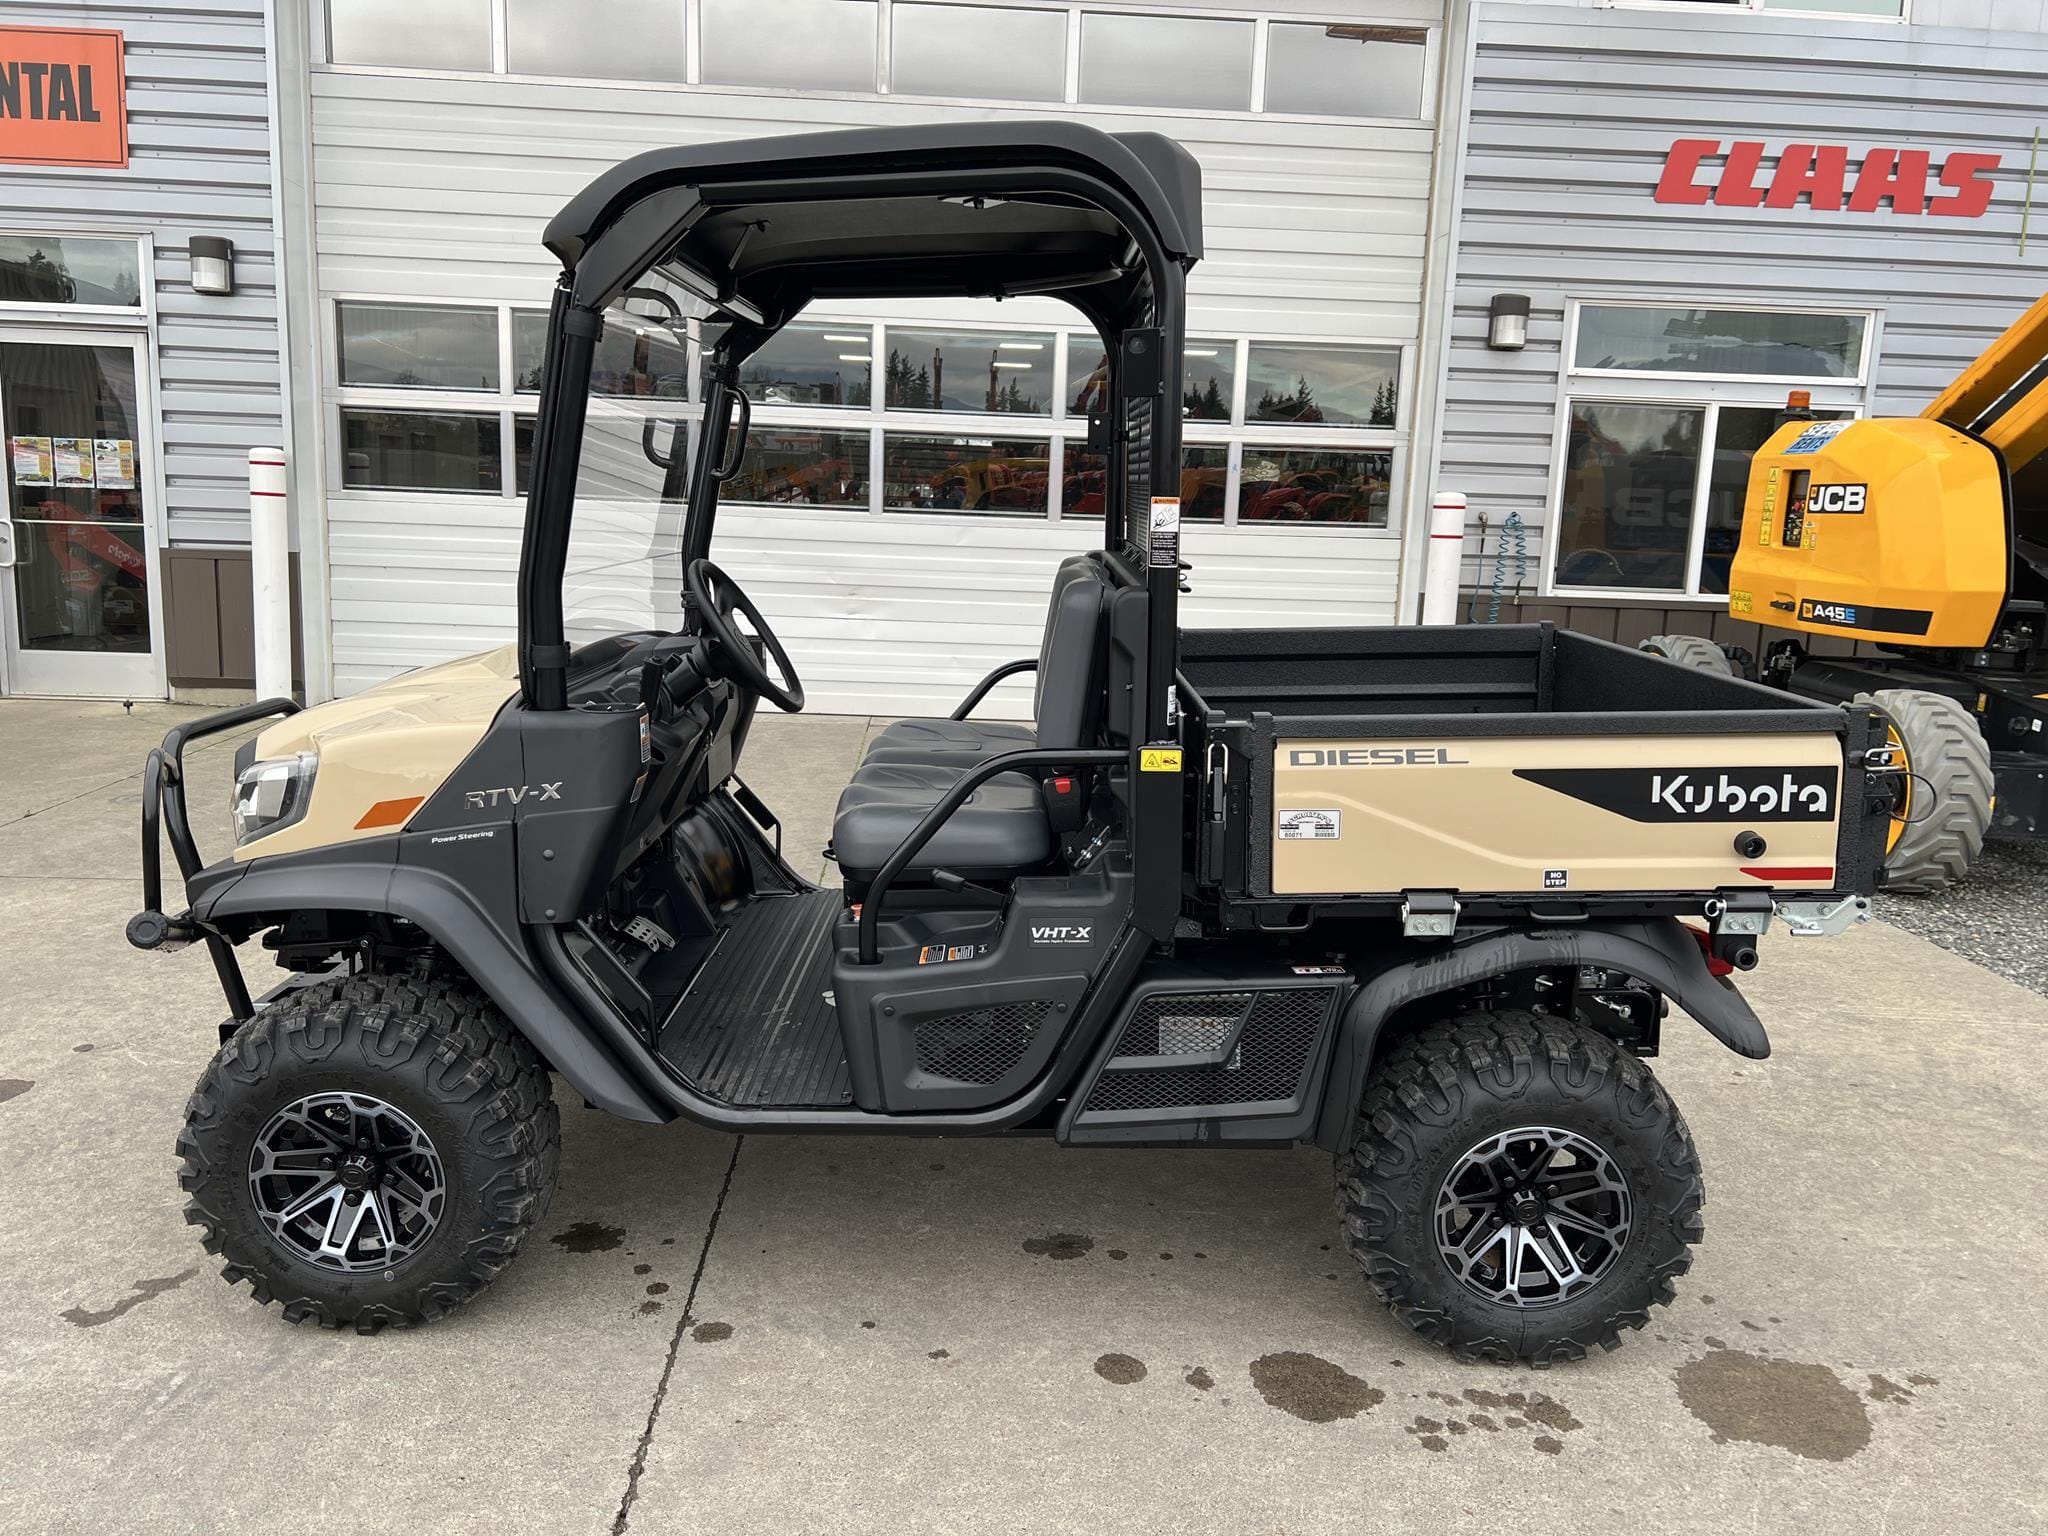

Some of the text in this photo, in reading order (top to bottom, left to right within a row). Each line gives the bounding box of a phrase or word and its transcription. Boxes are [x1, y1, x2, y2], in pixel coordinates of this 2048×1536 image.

[1654, 139, 2003, 218] CLAAS
[1808, 485, 1866, 512] JCB
[1813, 604, 1856, 621] A45E
[1290, 748, 1469, 766] DIESEL
[464, 781, 563, 809] RTV-X
[1651, 774, 1828, 813] Kubota
[431, 831, 494, 844] Power Steering
[1031, 926, 1092, 938] VHT-X
